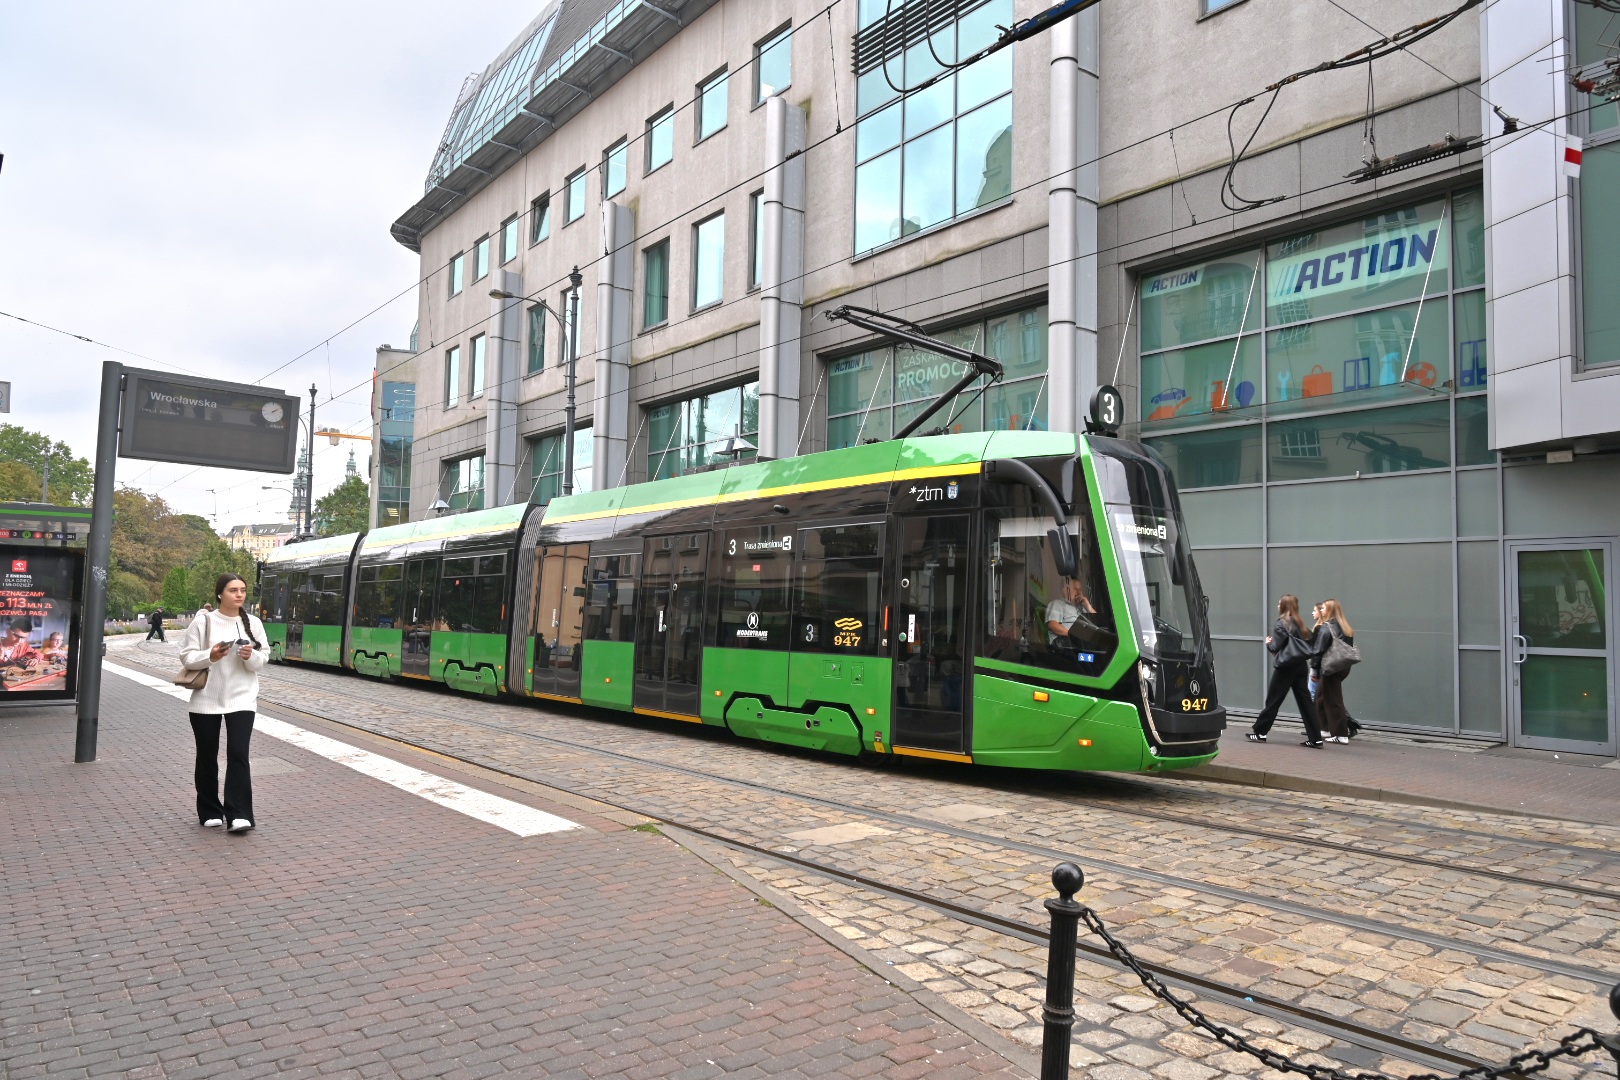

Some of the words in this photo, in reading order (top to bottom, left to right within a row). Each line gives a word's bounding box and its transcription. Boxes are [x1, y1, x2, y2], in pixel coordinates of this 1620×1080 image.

[1293, 229, 1438, 293] ACTION
[1151, 270, 1198, 293] ACTION
[834, 358, 860, 373] ACTION
[898, 361, 965, 388] PROMOC
[150, 391, 217, 408] Wrocławska
[1103, 393, 1115, 424] 3
[916, 485, 943, 501] ztm
[1125, 523, 1158, 537] zmieniona
[728, 538, 737, 556] 3
[6, 597, 27, 608] 113
[805, 624, 814, 642] 3
[834, 635, 861, 647] 947
[1181, 698, 1208, 711] 947
